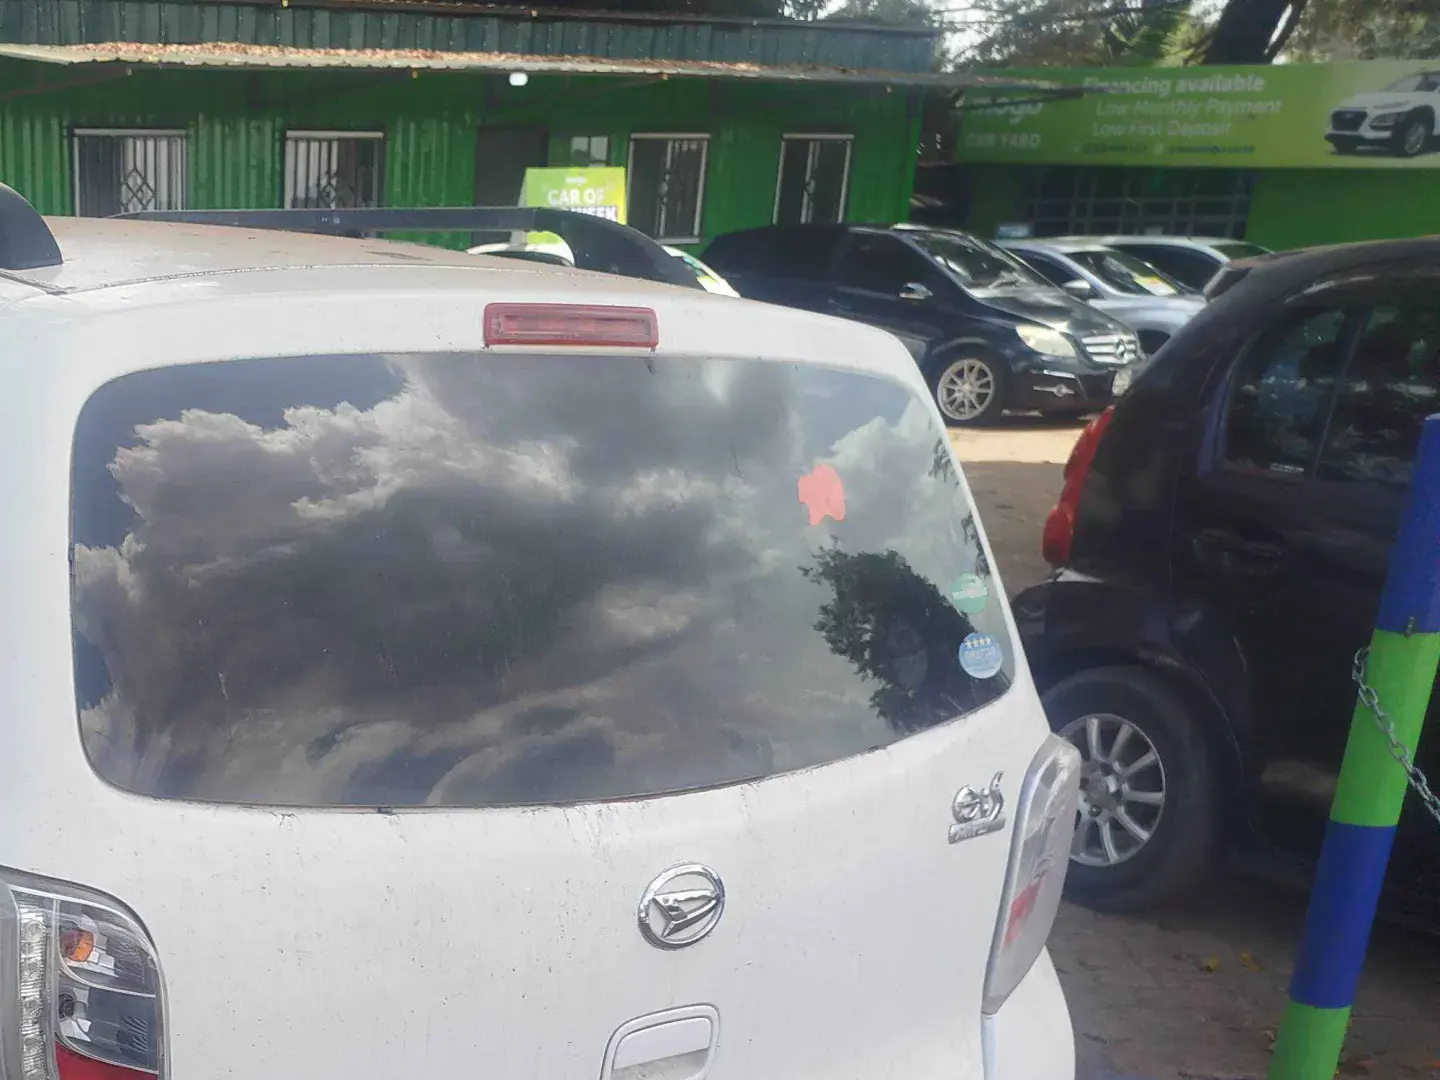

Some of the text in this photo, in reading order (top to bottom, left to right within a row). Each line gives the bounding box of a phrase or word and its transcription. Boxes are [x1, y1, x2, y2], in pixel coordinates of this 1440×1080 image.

[1175, 74, 1266, 92] available
[1096, 100, 1129, 116] Low
[547, 187, 604, 205] CAR OF
